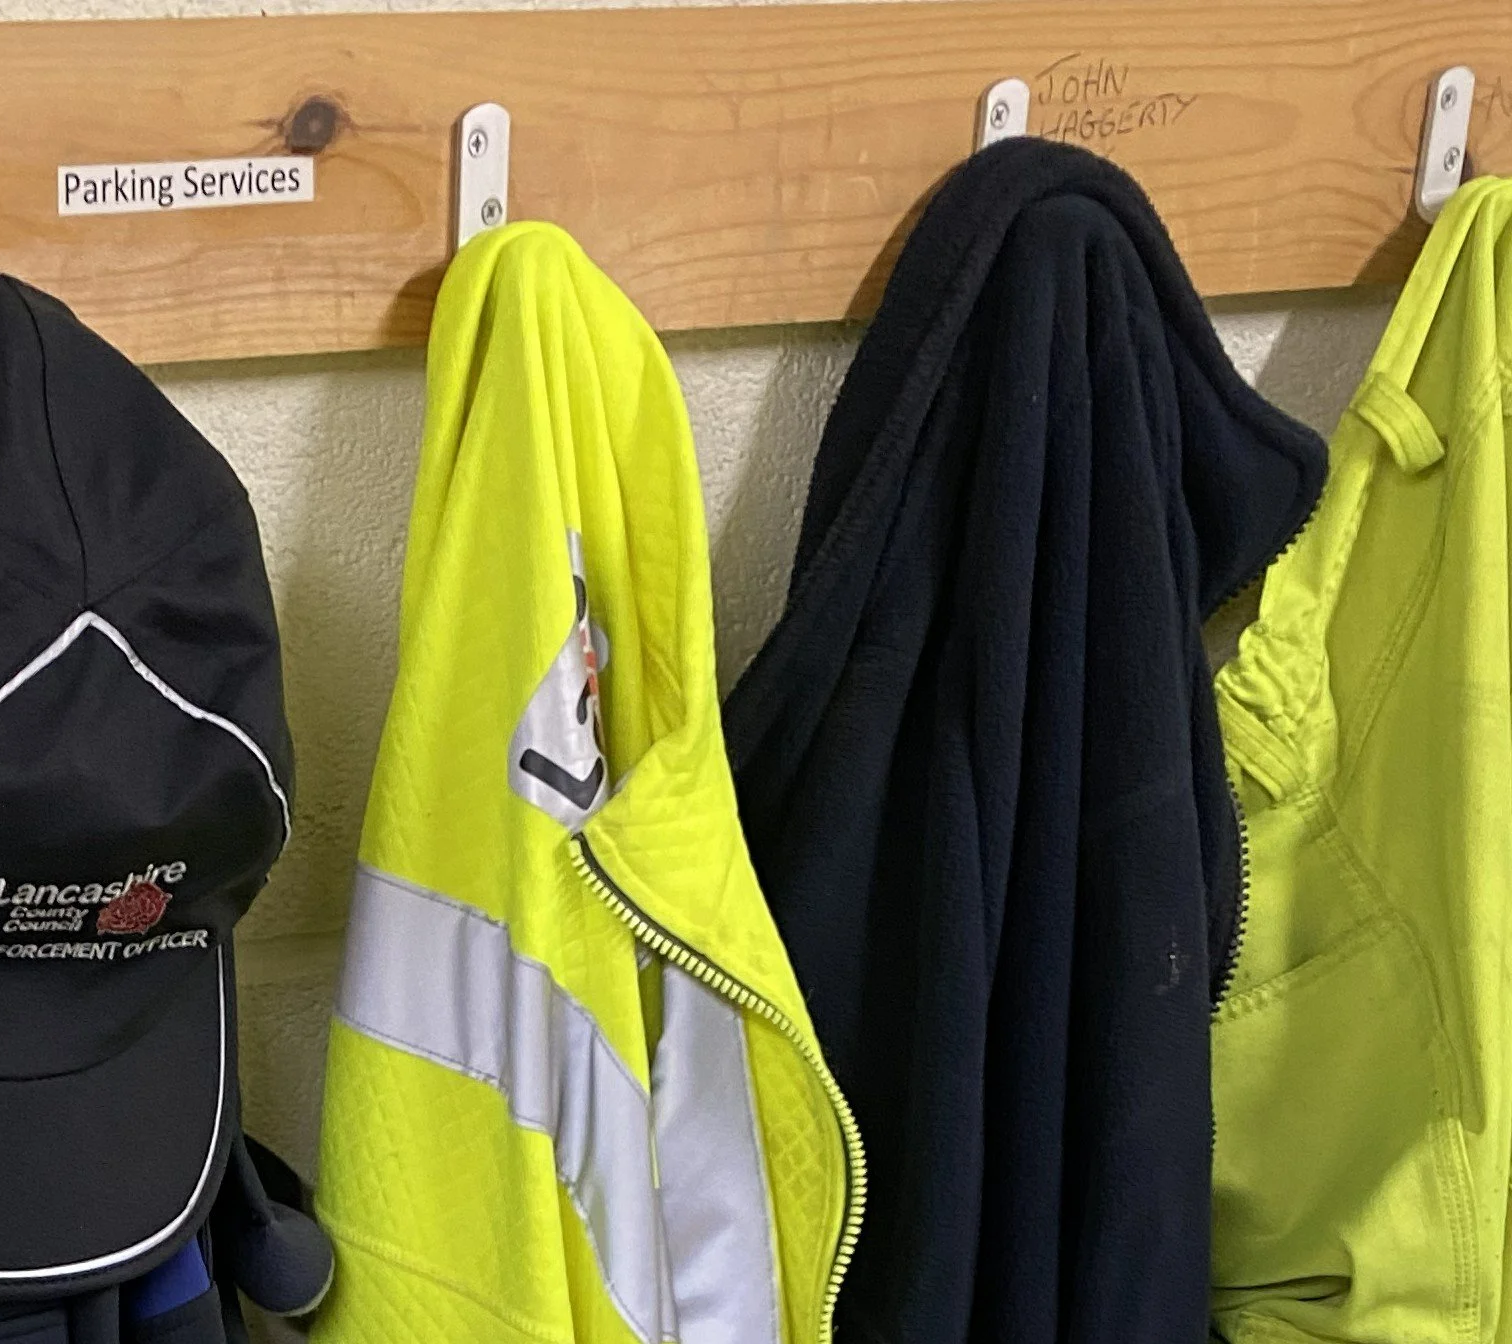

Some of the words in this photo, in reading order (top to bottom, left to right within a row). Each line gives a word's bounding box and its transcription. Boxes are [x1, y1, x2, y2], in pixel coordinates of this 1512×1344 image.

[1035, 52, 1129, 105] JOHN
[1040, 93, 1199, 142] HAGGERTY
[64, 167, 174, 207] Parking
[183, 162, 300, 198] Services
[2, 918, 84, 933] Council
[9, 905, 89, 919] County
[123, 929, 209, 958] OFFICER
